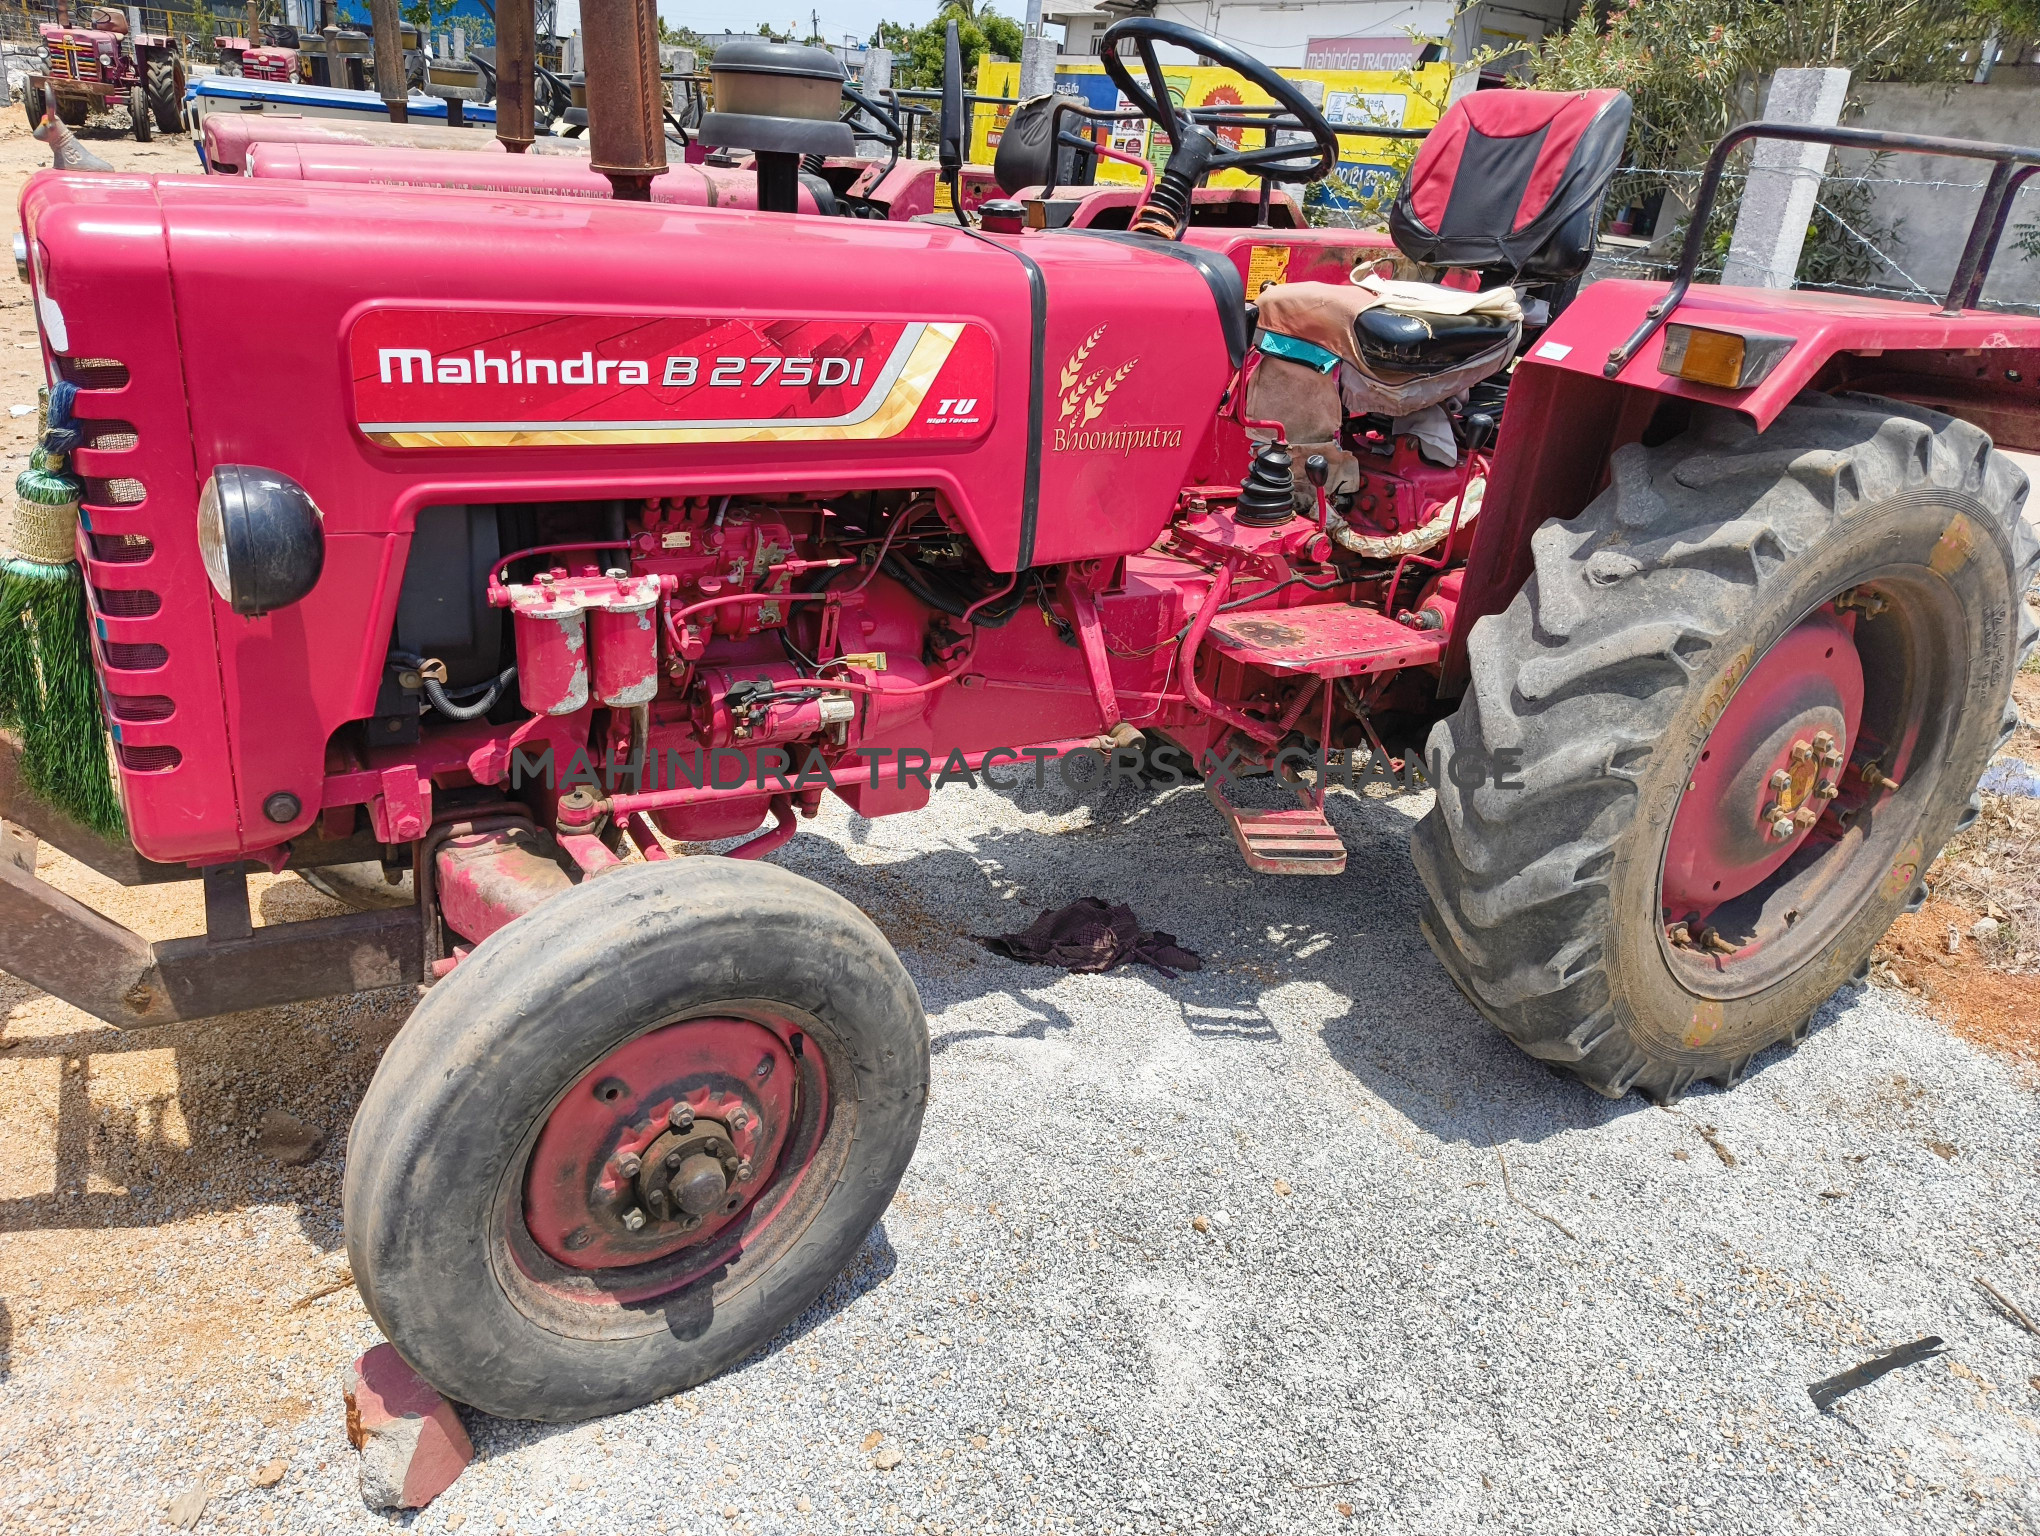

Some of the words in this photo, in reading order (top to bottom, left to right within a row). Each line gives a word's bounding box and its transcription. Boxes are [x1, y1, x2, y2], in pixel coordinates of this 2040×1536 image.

[1307, 47, 1360, 69] mahindra
[1362, 53, 1412, 70] TRACTORS
[378, 348, 649, 384] Mahindra
[661, 356, 699, 387] B
[937, 399, 978, 416] TU
[1052, 426, 1182, 458] Bhoomiputra
